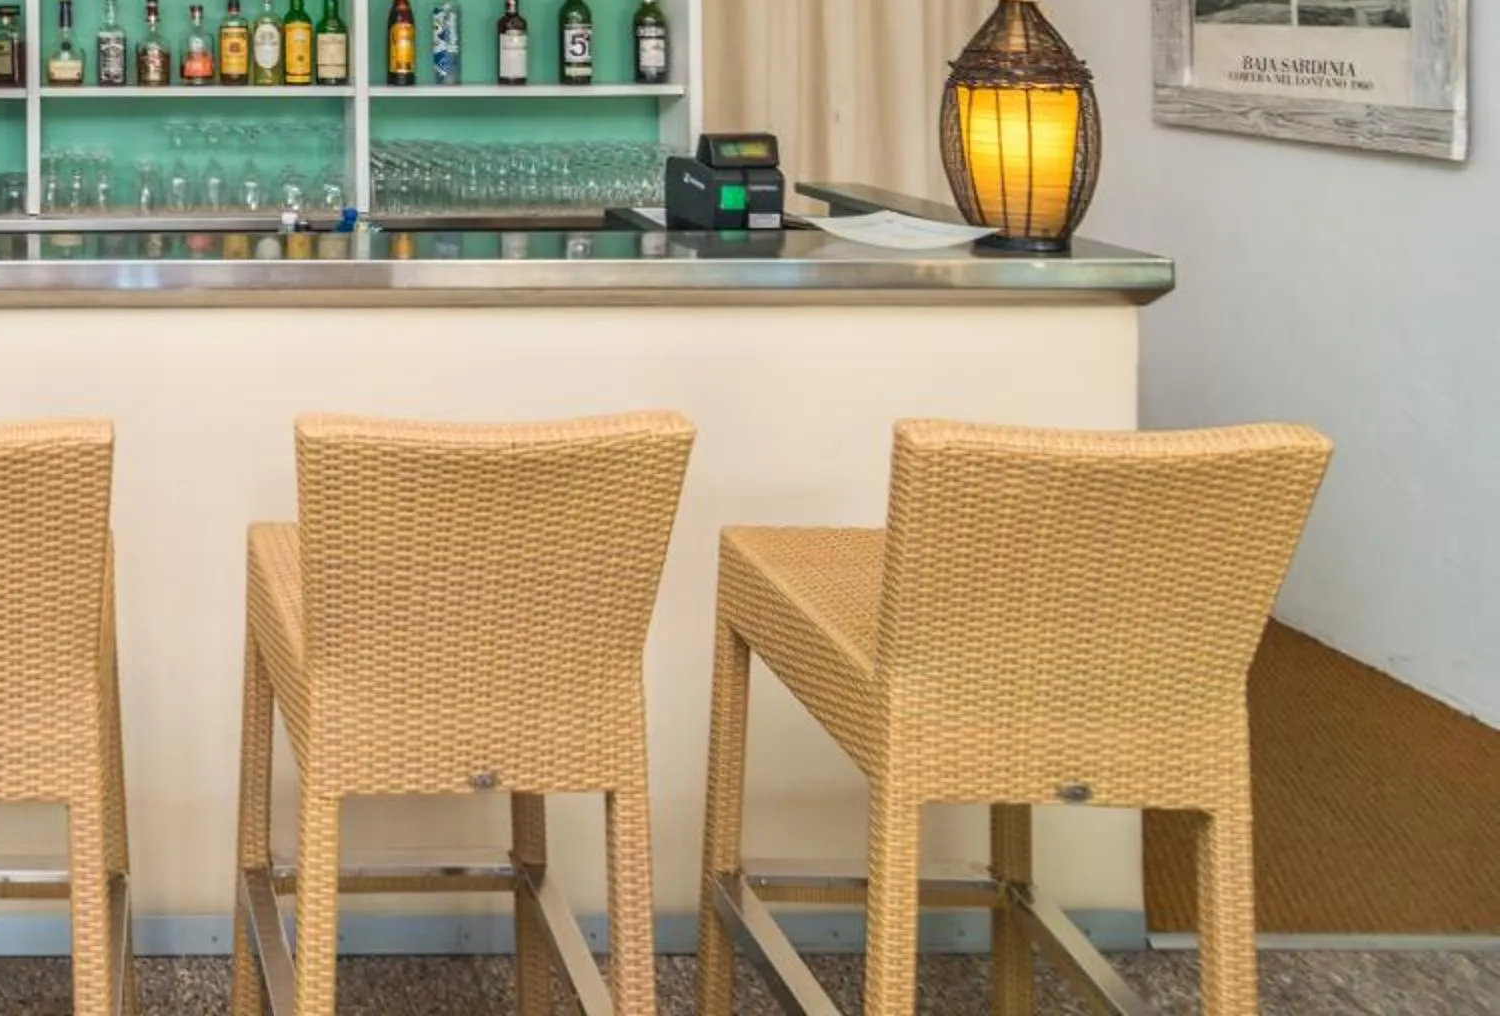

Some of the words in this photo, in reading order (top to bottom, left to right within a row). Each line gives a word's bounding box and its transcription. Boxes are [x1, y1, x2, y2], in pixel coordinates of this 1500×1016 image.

[570, 32, 588, 56] 5
[1243, 55, 1277, 72] BAJA
[1280, 58, 1355, 76] SARDINIA
